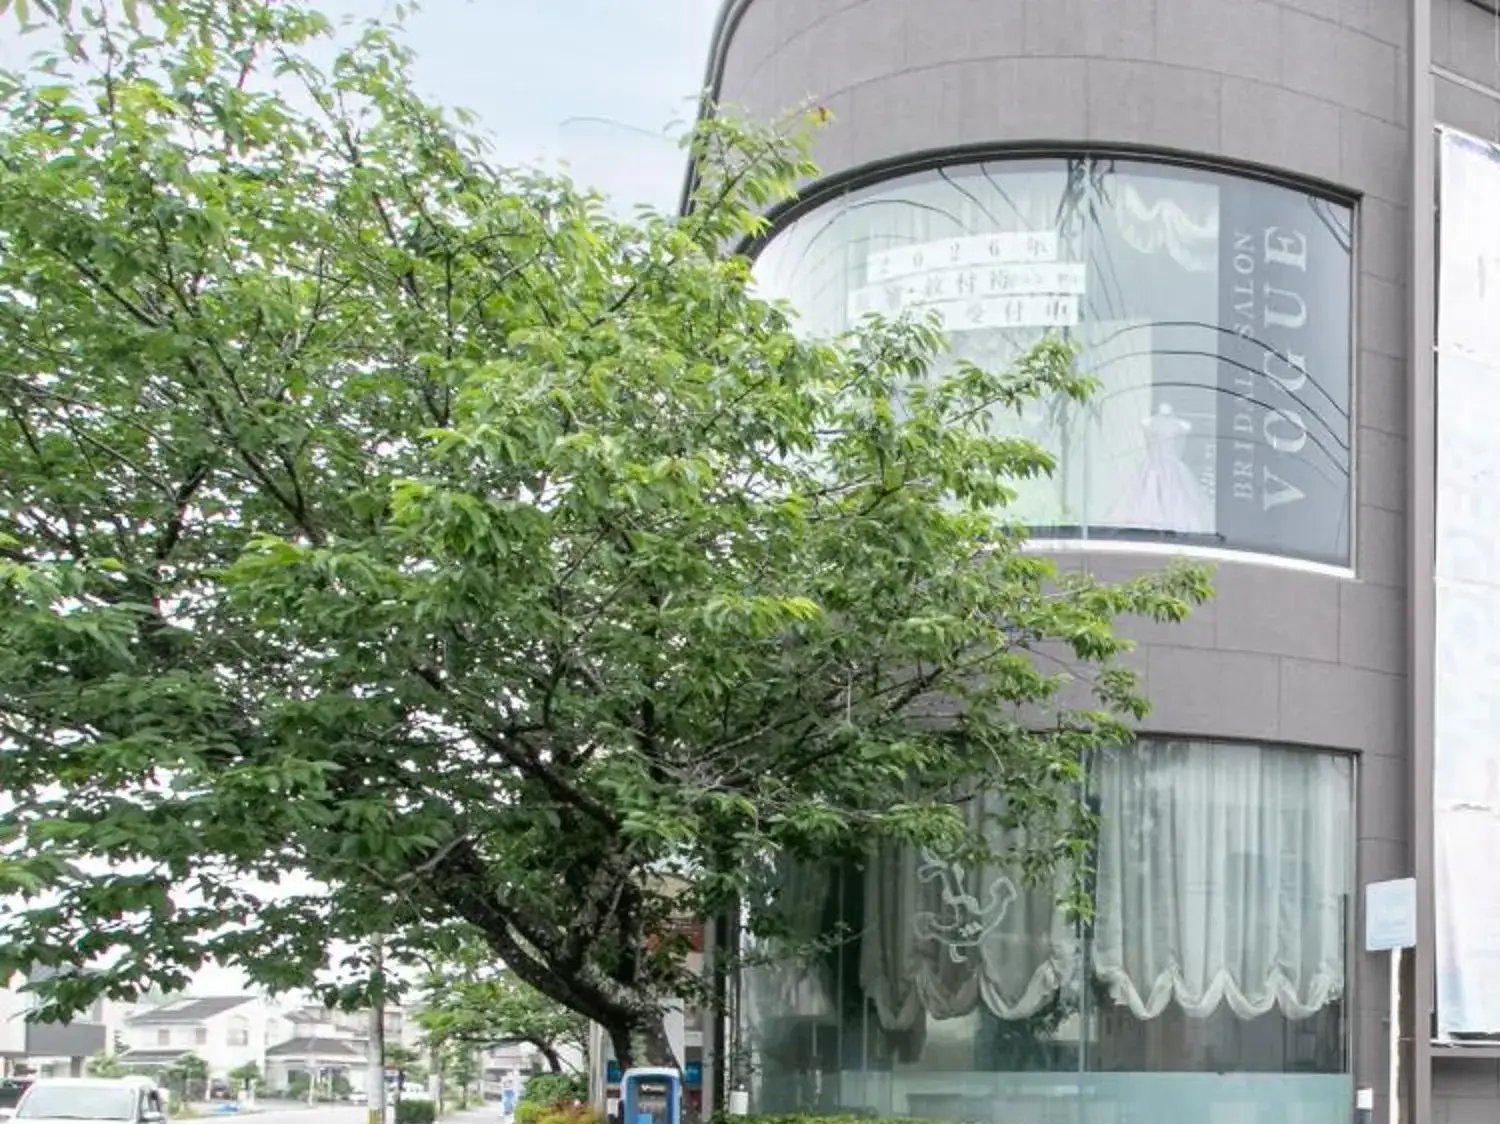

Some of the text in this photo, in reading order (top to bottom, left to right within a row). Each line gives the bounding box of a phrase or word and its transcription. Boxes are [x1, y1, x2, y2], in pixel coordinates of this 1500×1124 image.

[1232, 231, 1255, 499] BRIDAL SALON
[1263, 226, 1307, 512] VOGUE
